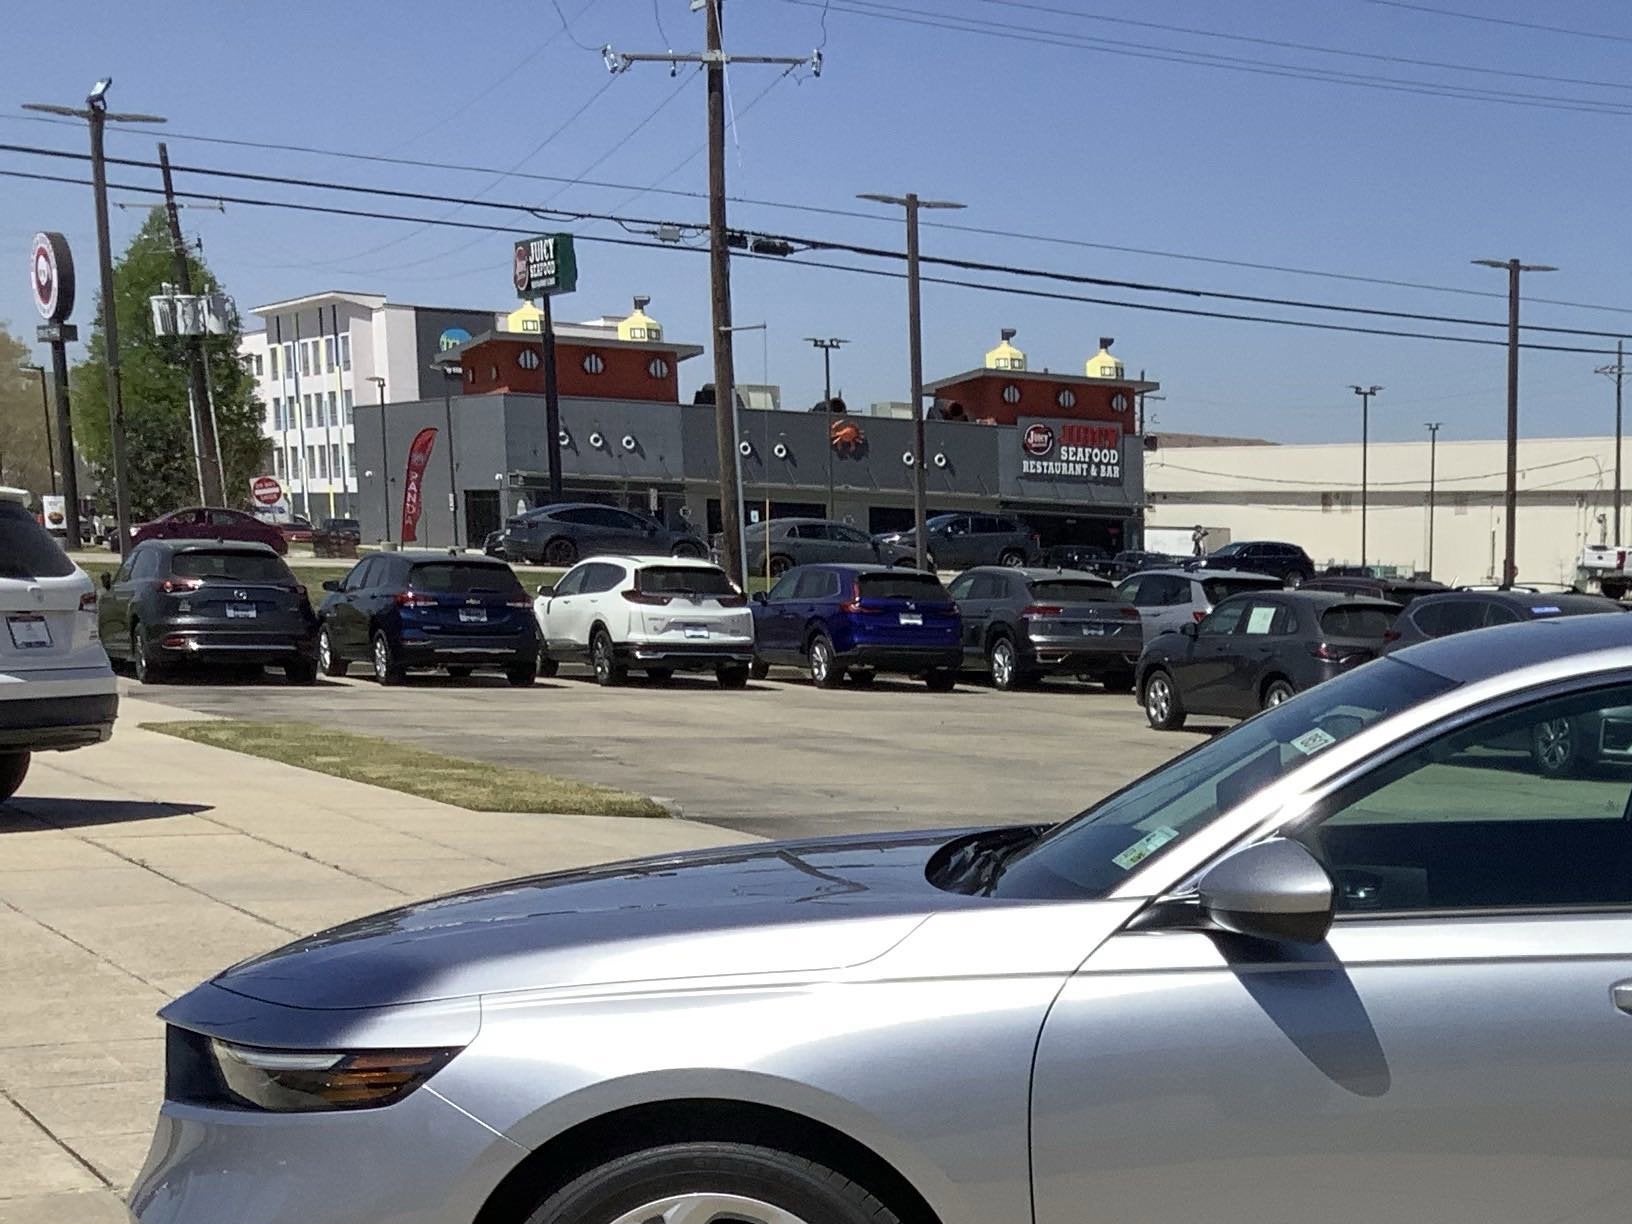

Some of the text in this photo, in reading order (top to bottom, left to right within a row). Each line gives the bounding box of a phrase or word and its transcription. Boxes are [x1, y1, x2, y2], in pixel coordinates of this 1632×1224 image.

[529, 238, 554, 263] JUICY
[530, 260, 555, 278] SEAFOOD
[1060, 446, 1118, 463] SEAFOOD
[1022, 460, 1120, 478] RESTAURANT & BAR
[407, 472, 418, 525] PANDA
